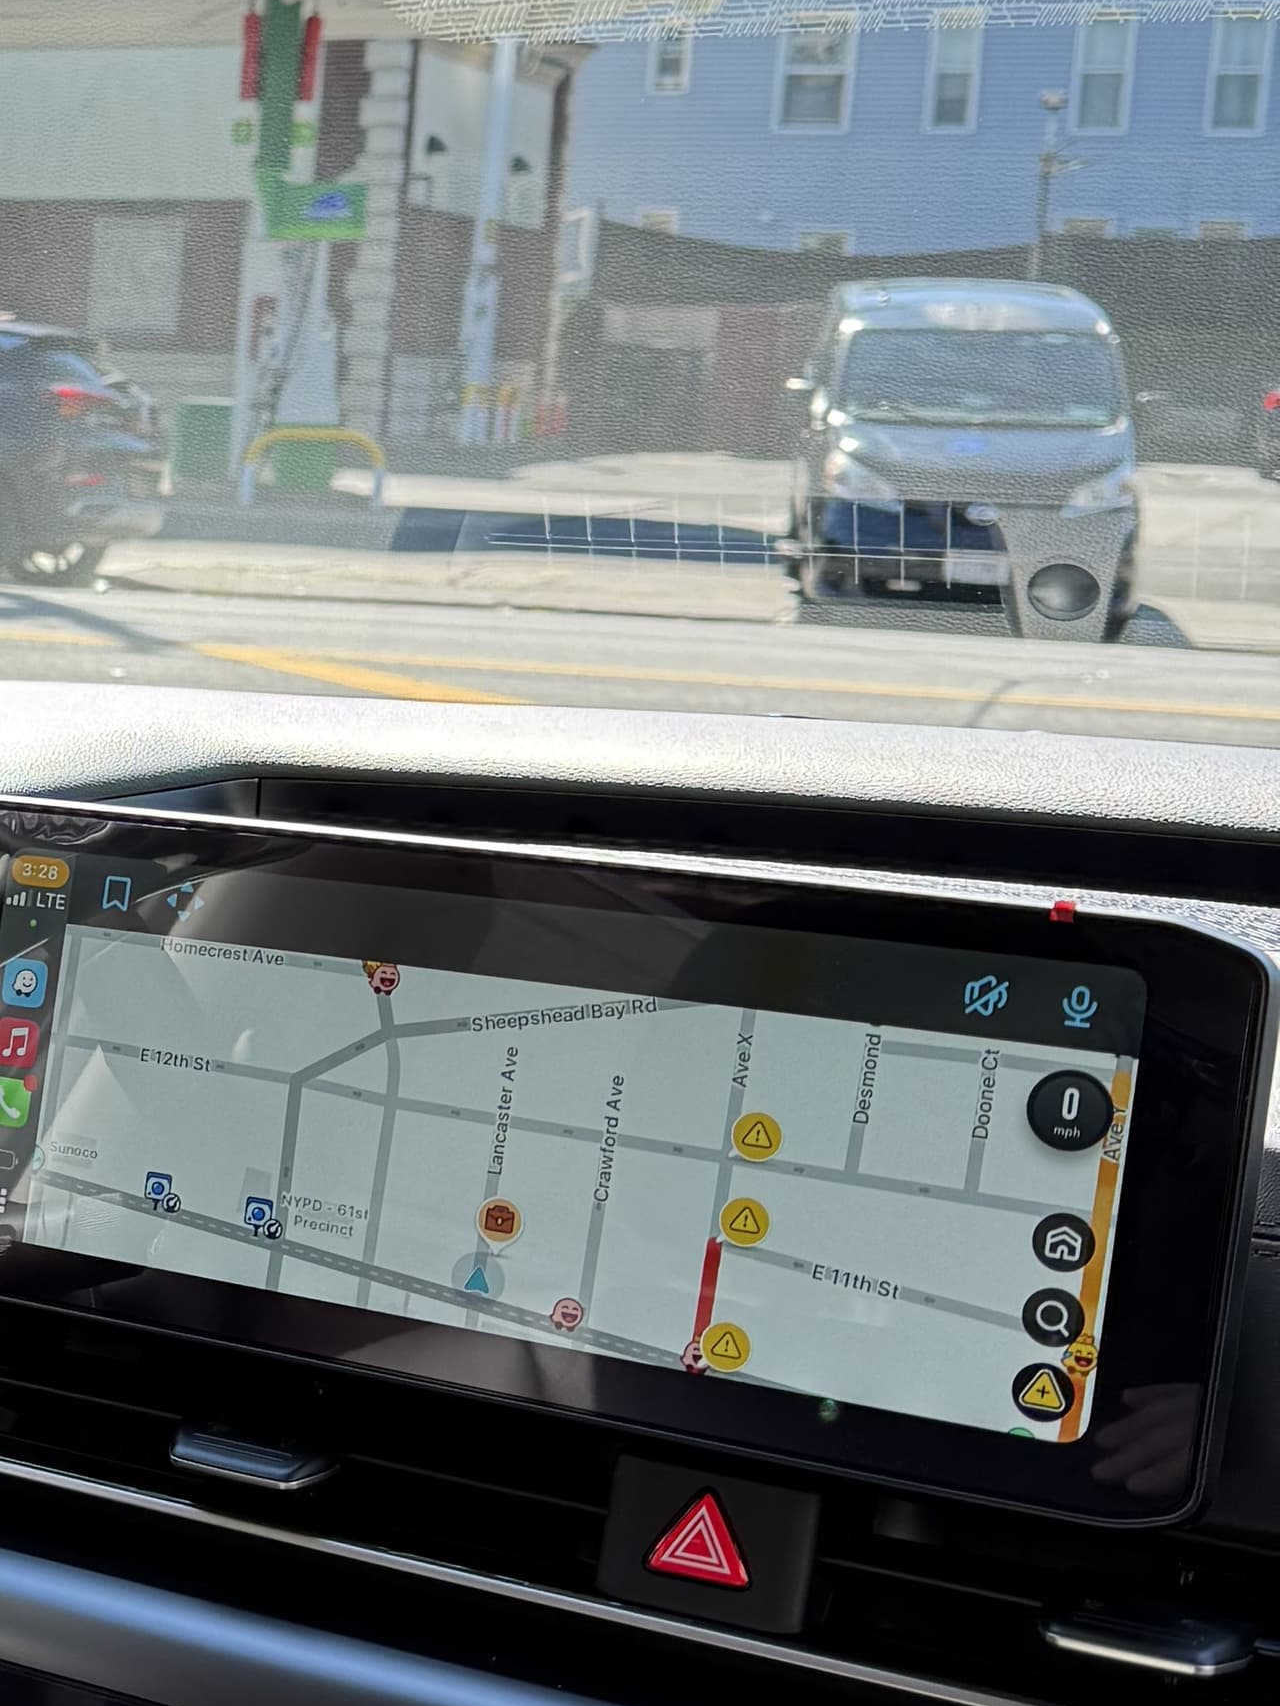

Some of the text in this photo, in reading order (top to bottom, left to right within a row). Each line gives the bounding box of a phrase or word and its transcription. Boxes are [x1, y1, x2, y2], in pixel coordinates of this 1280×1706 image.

[22, 863, 59, 880] 3:28
[36, 893, 66, 910] LTE
[160, 936, 285, 967] Homecrest Ave
[472, 997, 657, 1032] Sheepshead Bay Rd
[140, 1049, 211, 1072] E 12th St
[732, 1032, 753, 1088] Ave X
[852, 1033, 881, 1125] Desmond
[972, 1049, 1000, 1140] Doone Ct
[488, 1046, 519, 1176] Lancaster Ave
[1062, 1087, 1080, 1121] 0
[594, 1075, 625, 1202] Crawford Ave
[1053, 1126, 1081, 1139] mph
[1103, 1121, 1125, 1162] Ave
[50, 1141, 98, 1159] Sunoco
[282, 1194, 322, 1213] NYPD
[336, 1202, 368, 1220] 61st
[294, 1214, 354, 1238] Precinct
[811, 1265, 900, 1300] E 11th St
